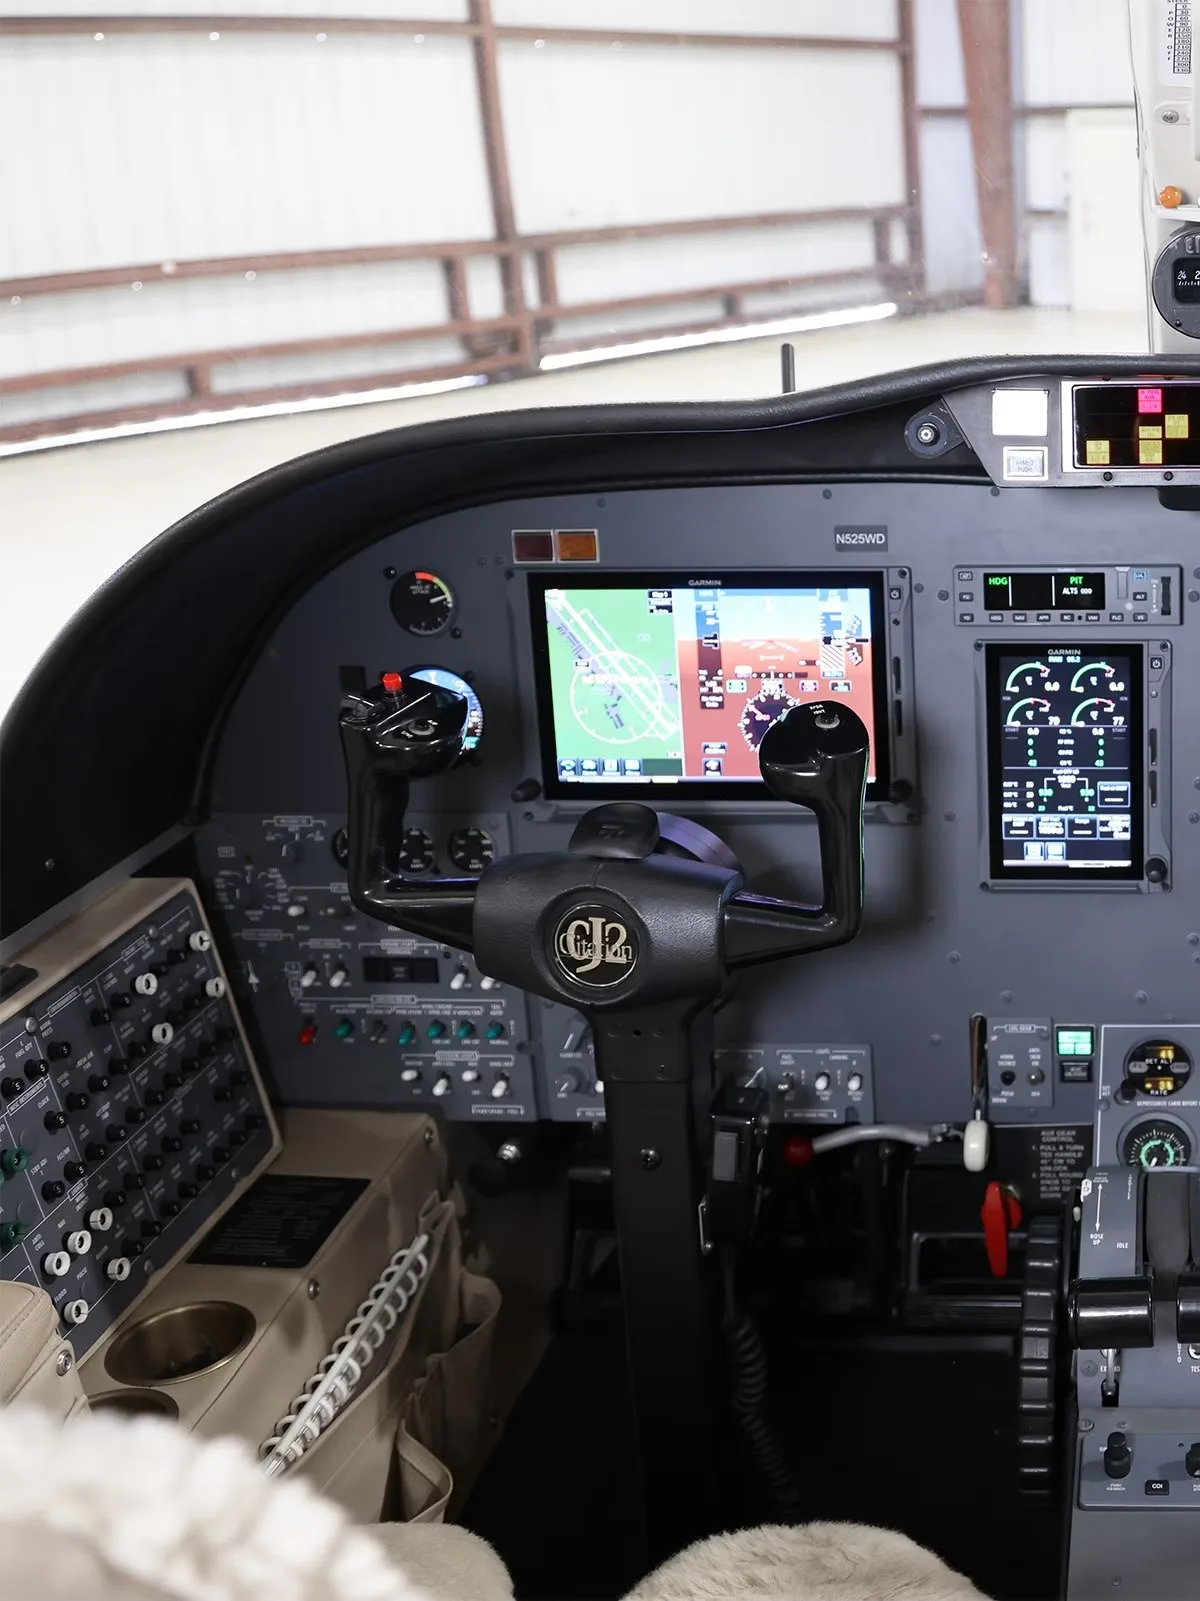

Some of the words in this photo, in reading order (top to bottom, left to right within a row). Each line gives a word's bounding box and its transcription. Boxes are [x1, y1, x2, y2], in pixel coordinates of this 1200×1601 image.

[1177, 270, 1187, 280] 24
[836, 533, 885, 545] N525WD
[988, 577, 1008, 585] HDG
[1069, 576, 1083, 585] PIT
[559, 933, 633, 960] Citation
[566, 917, 627, 974] CJ2
[15, 1046, 26, 1059] FUEL
[24, 1042, 33, 1051] QTY
[40, 1063, 46, 1072] 5
[15, 1082, 21, 1090] 5
[37, 1095, 50, 1108] CLOCK
[30, 1164, 40, 1175] STBY
[40, 1158, 48, 1167] ADI
[32, 1233, 42, 1245] ANTI
[35, 1240, 45, 1251] COLL
[76, 1266, 88, 1280] PULSE
[54, 1288, 68, 1303] FLOOD
